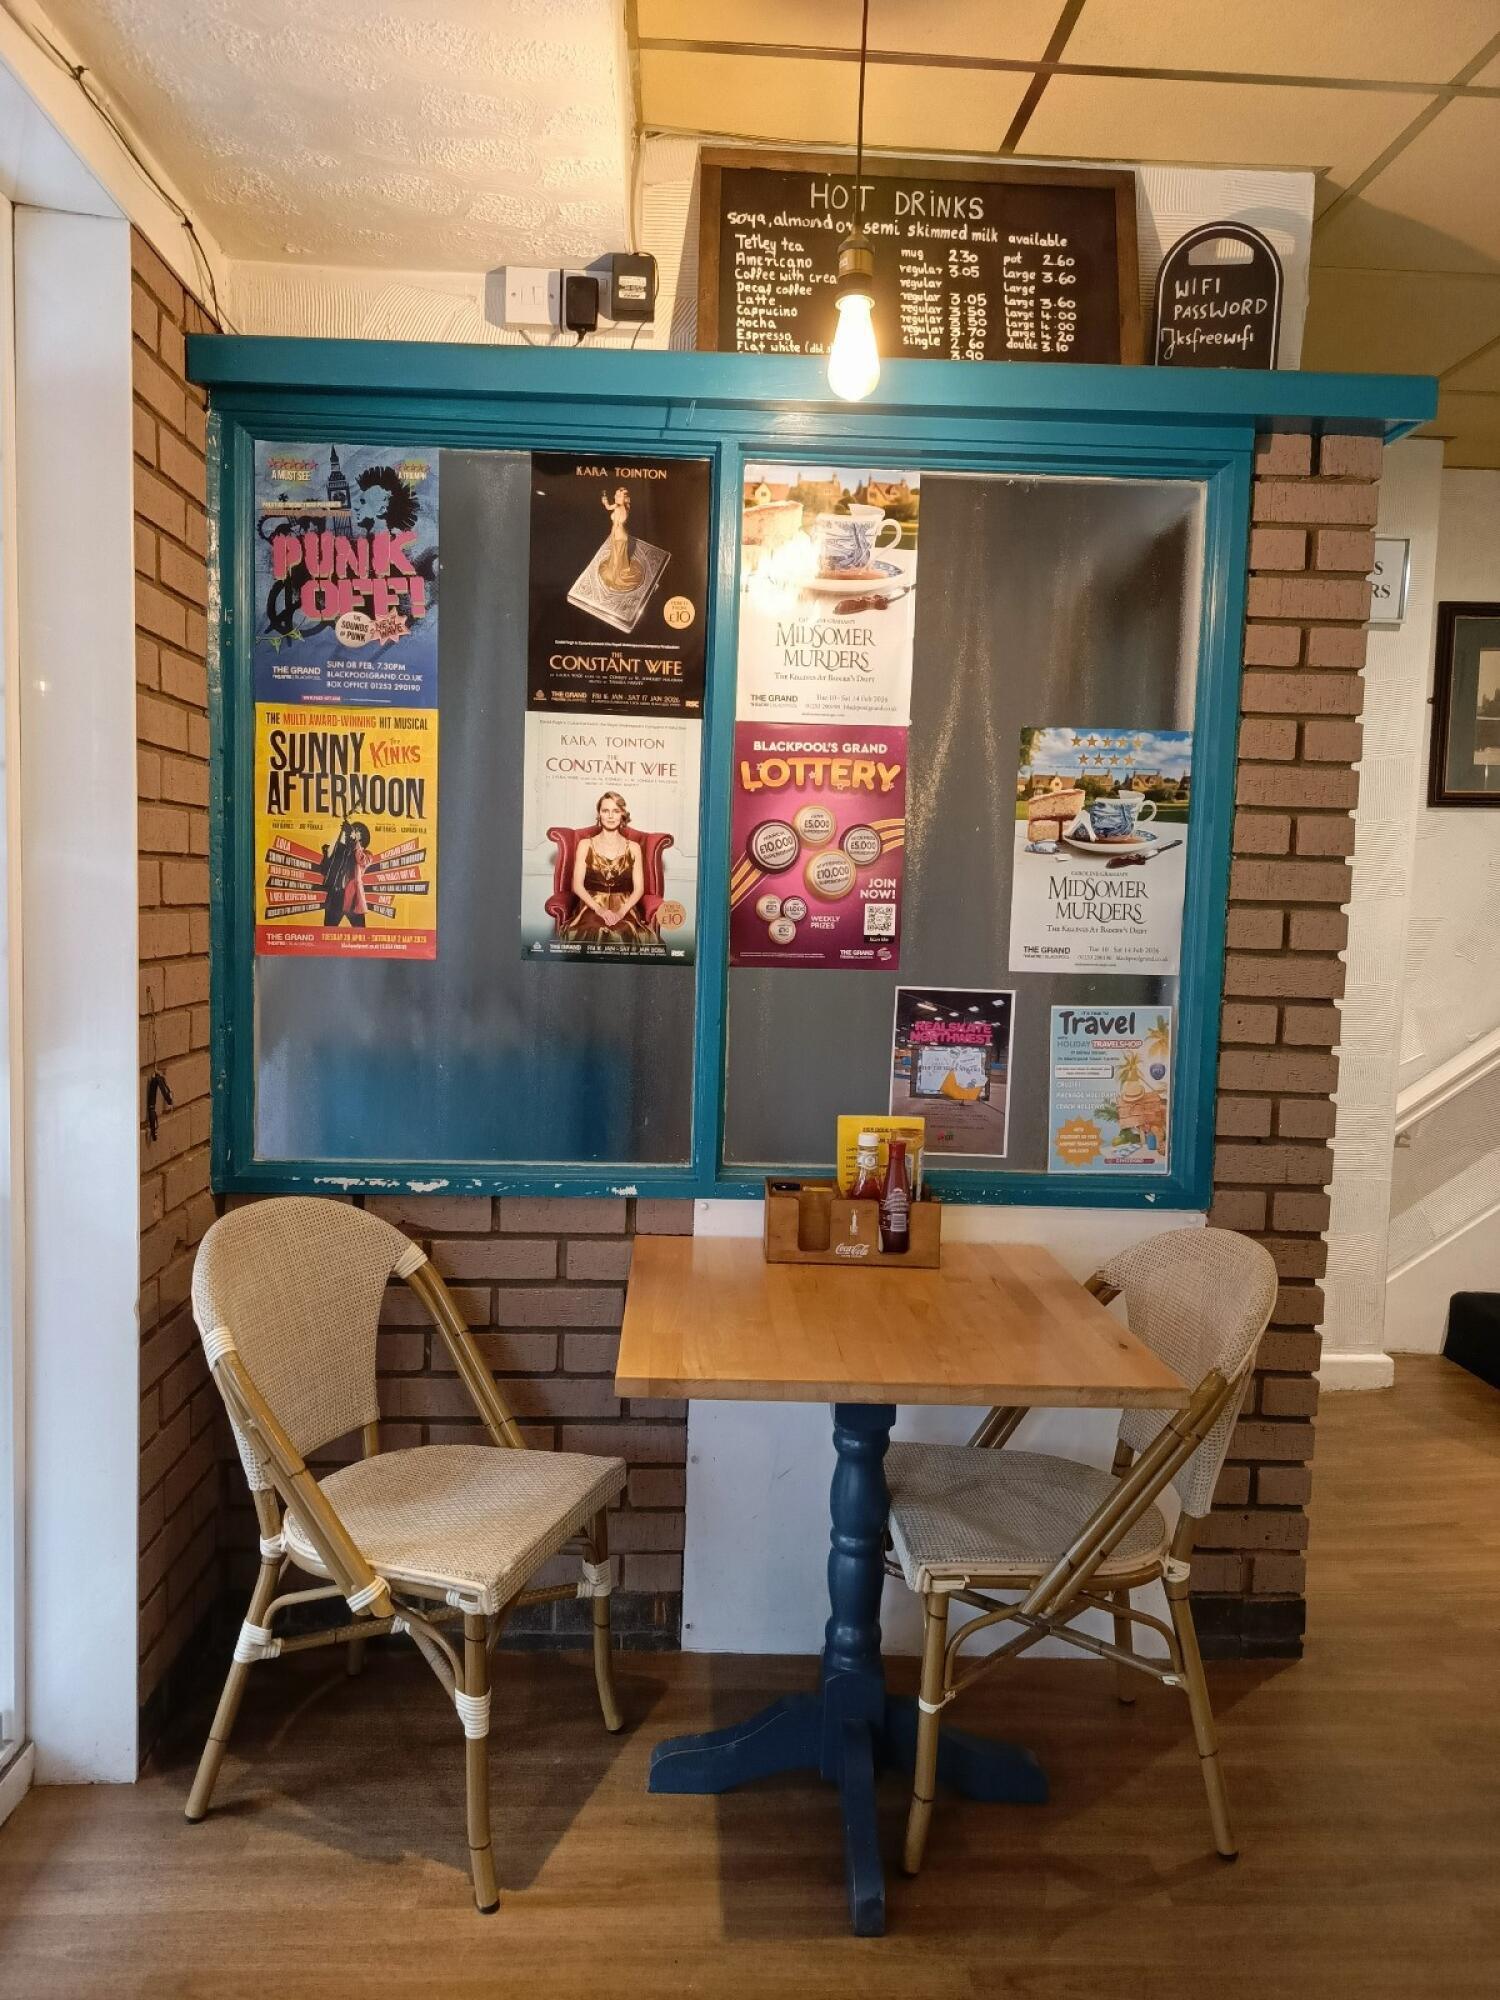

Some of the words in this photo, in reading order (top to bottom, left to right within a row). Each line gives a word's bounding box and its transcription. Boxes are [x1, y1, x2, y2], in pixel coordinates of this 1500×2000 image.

[811, 182, 875, 211] HOT
[773, 211, 833, 230] almond
[862, 219, 900, 235] semi
[907, 222, 968, 241] skimmed
[971, 228, 998, 243] milk
[1008, 232, 1068, 248] available
[735, 234, 777, 257] Tetley
[781, 237, 805, 252] tea
[900, 249, 924, 260] mug
[948, 249, 979, 263] 2.30
[1003, 252, 1023, 266] pot
[1042, 254, 1076, 267] 2.60
[735, 252, 813, 269] Americano
[899, 262, 943, 277] regular
[949, 264, 980, 278] 3.05
[1041, 272, 1076, 285] 3.60
[735, 268, 776, 281] Coffee
[780, 269, 804, 282] with
[810, 273, 838, 284] crea
[899, 277, 942, 290] regular
[1175, 277, 1221, 299] WIFI
[735, 281, 772, 295] Decaf
[776, 284, 812, 296] coffee
[900, 290, 942, 302] regular
[950, 293, 987, 307] 3.05
[1040, 297, 1076, 310] 3.60
[736, 293, 776, 306] Latte
[900, 303, 942, 314] regular
[1174, 298, 1268, 321] PASSWORD
[736, 317, 776, 329] Mocha
[901, 323, 945, 335] regular
[900, 314, 942, 326] regular
[736, 328, 792, 342] Espresso
[902, 336, 941, 350] single
[1006, 338, 1038, 350] double
[771, 341, 800, 353] white
[277, 470, 297, 481] MUST
[297, 471, 312, 481] SEE
[576, 466, 608, 477] KARA
[614, 467, 668, 479] TOINTON
[272, 528, 418, 580] PUNK
[301, 576, 426, 621] OFF!
[669, 611, 691, 623] £10
[341, 621, 369, 632] SOUNDS
[776, 622, 876, 648] MIDSOMER
[346, 631, 366, 642] PUNK
[327, 661, 344, 669] SUN
[549, 654, 641, 673] CONSTANT
[645, 659, 683, 676] WIFE
[784, 649, 873, 673] MURDERS
[272, 666, 289, 674] THE
[290, 667, 321, 675] GRAND
[327, 681, 342, 689] BOX
[343, 681, 369, 690] OFFICE
[750, 694, 767, 702] THE
[768, 695, 798, 703] GRAND
[266, 712, 280, 725] THE
[379, 716, 391, 729] HIT
[393, 717, 428, 730] MUSICAL
[560, 734, 597, 748] KARA
[605, 736, 665, 750] TOINTON
[753, 740, 839, 753] BLACKPOOL'S
[842, 743, 888, 754] GRAND
[269, 730, 366, 775] SUNNY
[369, 740, 421, 769] KINKS
[545, 757, 637, 775] CONSTANT
[640, 762, 678, 777] WIFE
[740, 757, 901, 792] LOTTERY
[267, 770, 428, 820] AFTERNOON
[868, 878, 896, 888] JOIN
[1048, 876, 1149, 901] MIDSOMER
[860, 889, 896, 899] NOW!
[661, 912, 682, 926] £10
[811, 915, 841, 923] WEEKLY
[1056, 902, 1147, 925] MURDERS
[811, 922, 836, 930] PRIZES
[266, 932, 283, 941] THE
[285, 933, 315, 942] GRAND
[1041, 946, 1071, 954] GRAND
[1059, 1010, 1136, 1036] Travel
[910, 1031, 993, 1045] NORTHWEST
[1057, 1040, 1091, 1048] HOLIDAY
